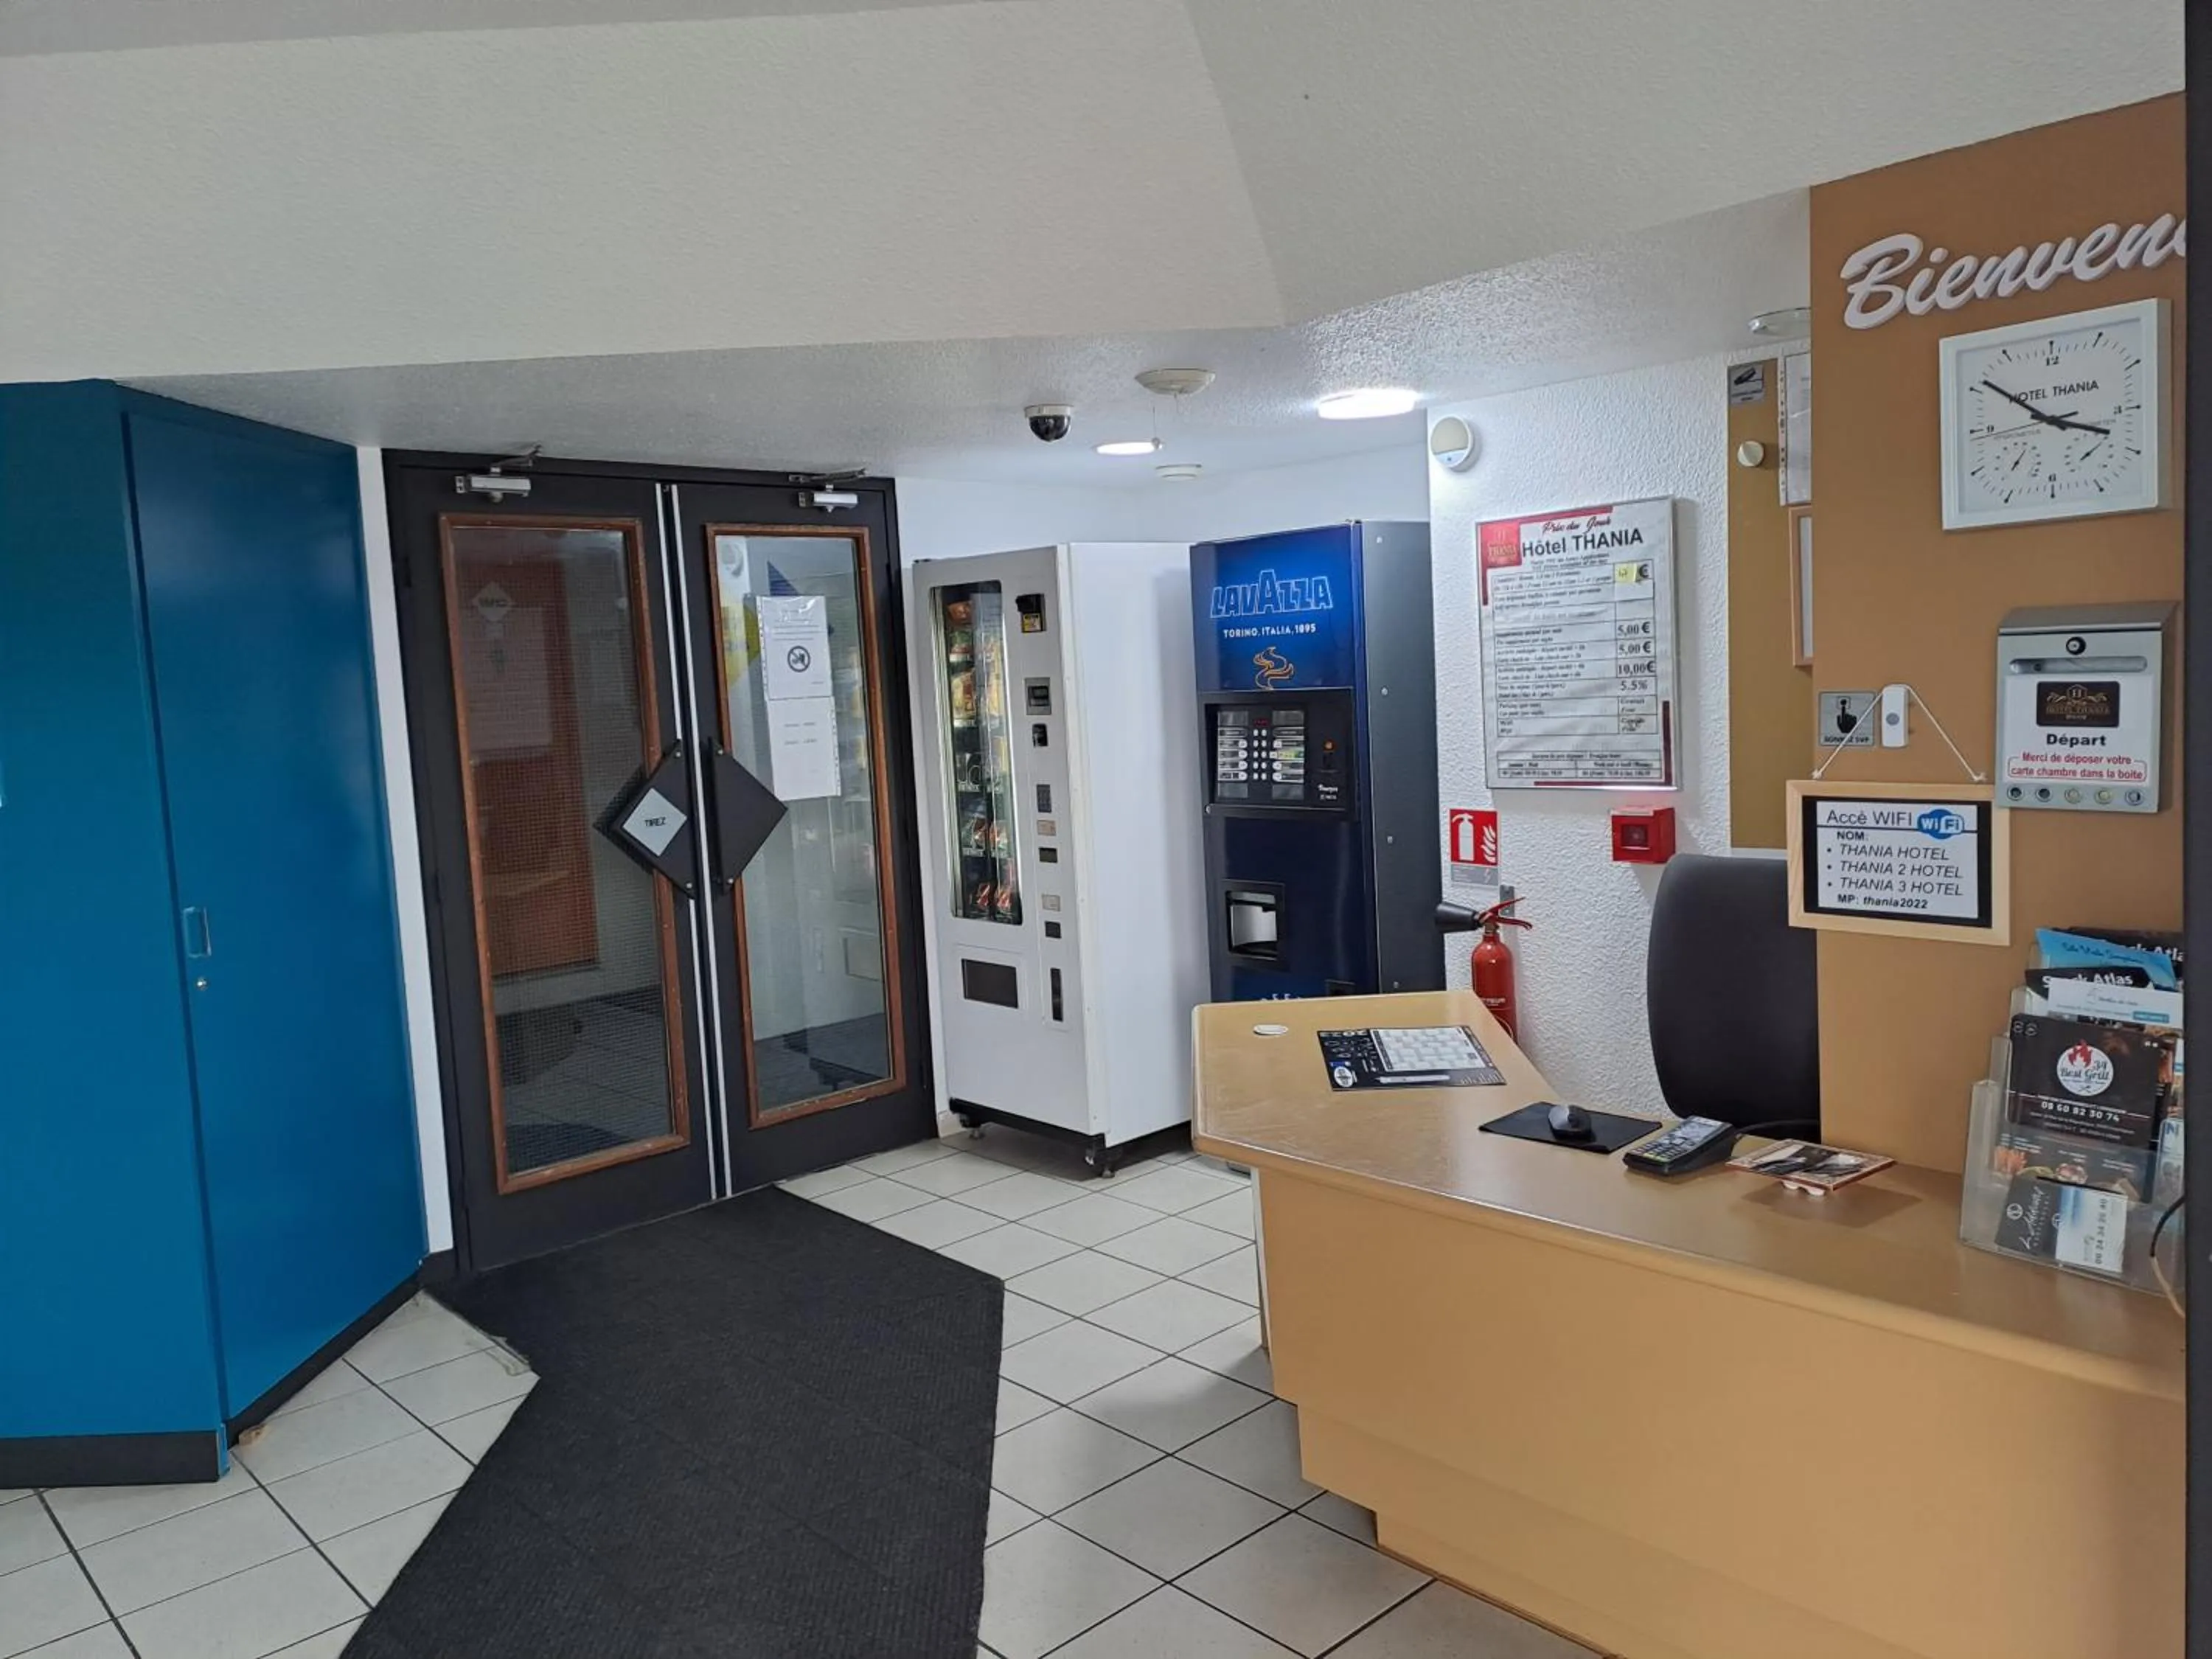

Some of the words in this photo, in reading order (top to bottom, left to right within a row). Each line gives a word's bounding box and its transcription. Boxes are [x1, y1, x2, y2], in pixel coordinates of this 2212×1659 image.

[1840, 214, 2185, 329] Bienven
[2045, 356, 2059, 366] 12
[2008, 389, 2048, 404] HOTEL
[2053, 380, 2099, 397] THANIA
[2113, 406, 2122, 414] 3
[1986, 425, 1994, 434] 9
[2048, 473, 2056, 481] 6
[1522, 537, 1567, 557] Hôtel
[1571, 528, 1644, 552] THANIA
[1210, 568, 1333, 618] LAVAZZA
[1641, 622, 1651, 633] €
[1643, 641, 1652, 653] €
[2046, 733, 2107, 748] Départ
[2023, 751, 2048, 762] Merci
[2051, 753, 2061, 762] de
[2065, 754, 2103, 766] déposer
[2107, 755, 2132, 765] votre
[2011, 766, 2034, 776] carte
[2036, 767, 2077, 777] chambre
[2080, 768, 2103, 778] dans
[2107, 769, 2115, 779] la
[1873, 812, 1912, 827] WIFI
[1837, 831, 1868, 841] NOM:
[1840, 844, 1893, 858] THANIA
[1897, 847, 1950, 860] HOTEL
[1840, 860, 1893, 874] THANIA
[1898, 863, 1907, 875] 2
[1910, 865, 1964, 878] HOTEL
[1840, 877, 1894, 891] THANIA
[1898, 880, 1907, 892] 3
[1910, 882, 1964, 896] HOTEL
[1837, 894, 1859, 904] MP:
[1863, 895, 1929, 909] thania2022
